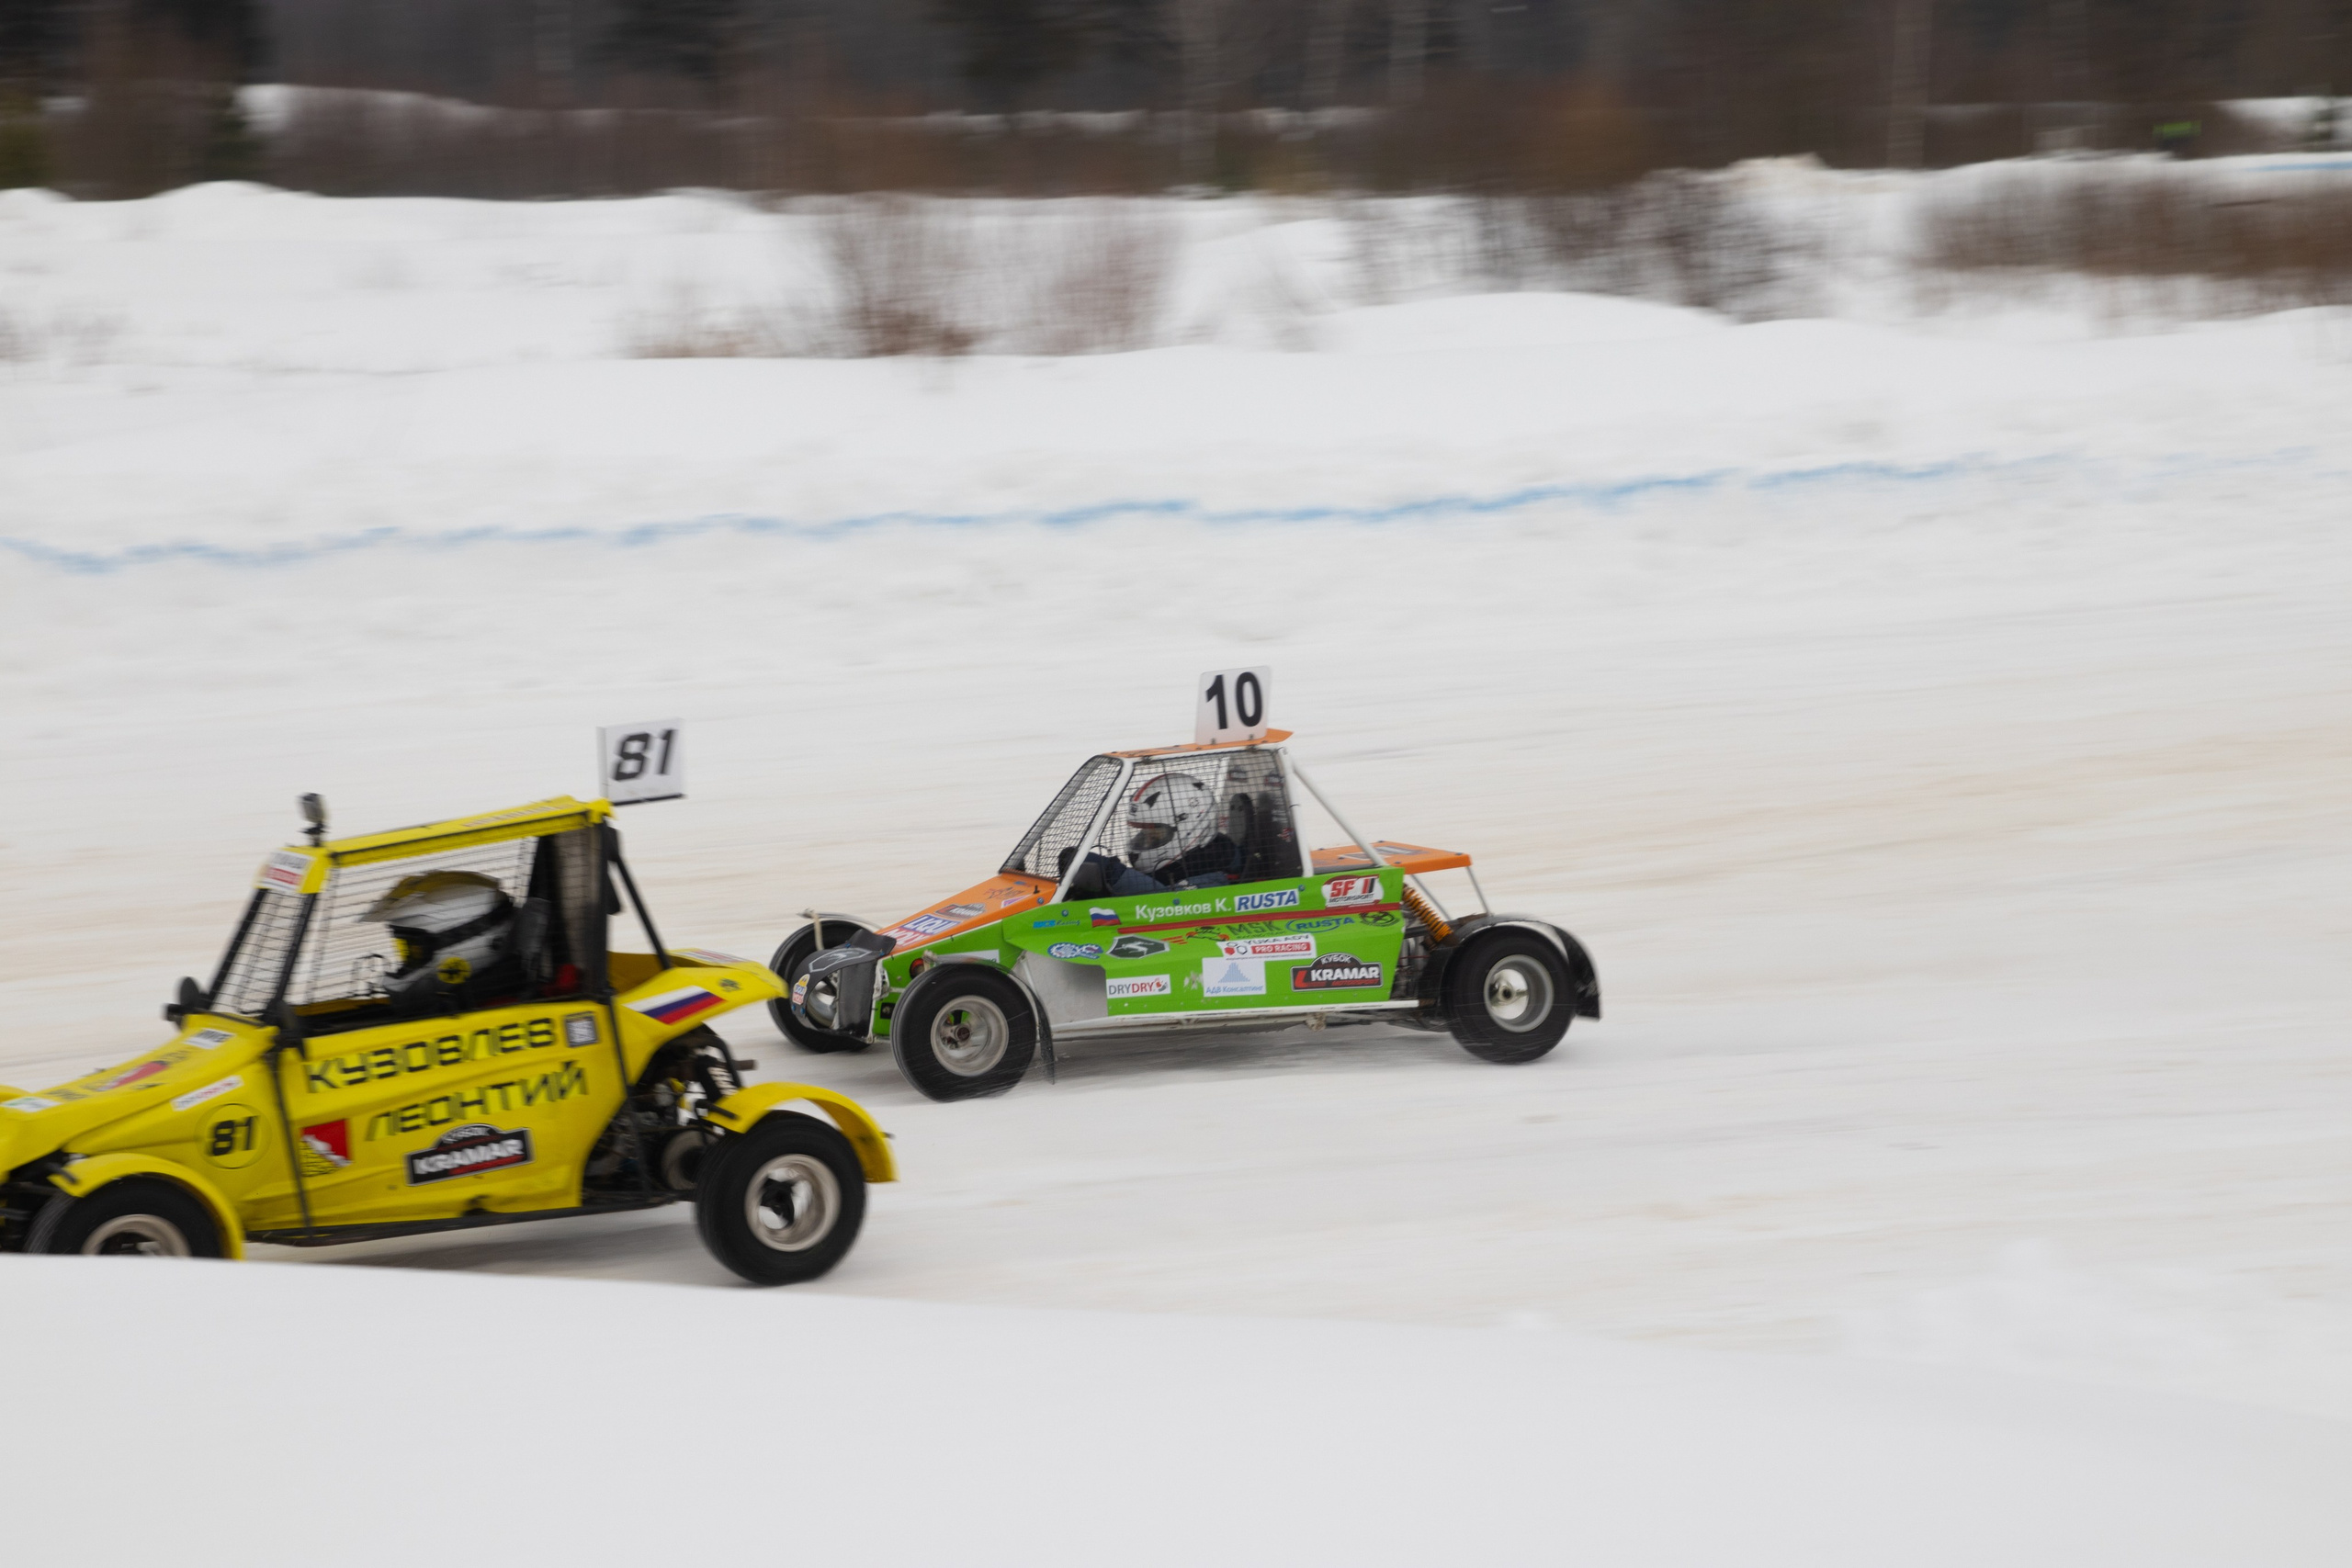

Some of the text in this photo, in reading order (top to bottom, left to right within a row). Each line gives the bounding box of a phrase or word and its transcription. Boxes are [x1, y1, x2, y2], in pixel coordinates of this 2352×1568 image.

[1205, 671, 1262, 729] 10
[612, 728, 678, 782] 81
[1329, 893, 1374, 903] MOTORSPORT
[1330, 879, 1356, 898] SF
[1136, 897, 1232, 921] Кузовков К.
[1237, 890, 1298, 911] RUSTA
[903, 915, 959, 935] LIQUI
[1227, 920, 1283, 937] MSK
[1295, 917, 1355, 931] RUSTA
[882, 927, 930, 948] MOLY
[1254, 942, 1307, 954] PRO RACING
[1320, 953, 1351, 965] КУБОК
[1310, 966, 1380, 982] KRAMAR
[1109, 982, 1154, 995] DRYDRY
[1205, 984, 1263, 995] АДВ Консалтинг
[306, 1017, 556, 1093] КУЗОВЛЕВ
[365, 1060, 588, 1142] ЛЕОНТИЙ
[208, 1114, 259, 1156] 81
[413, 1138, 525, 1175] KRAMAR
